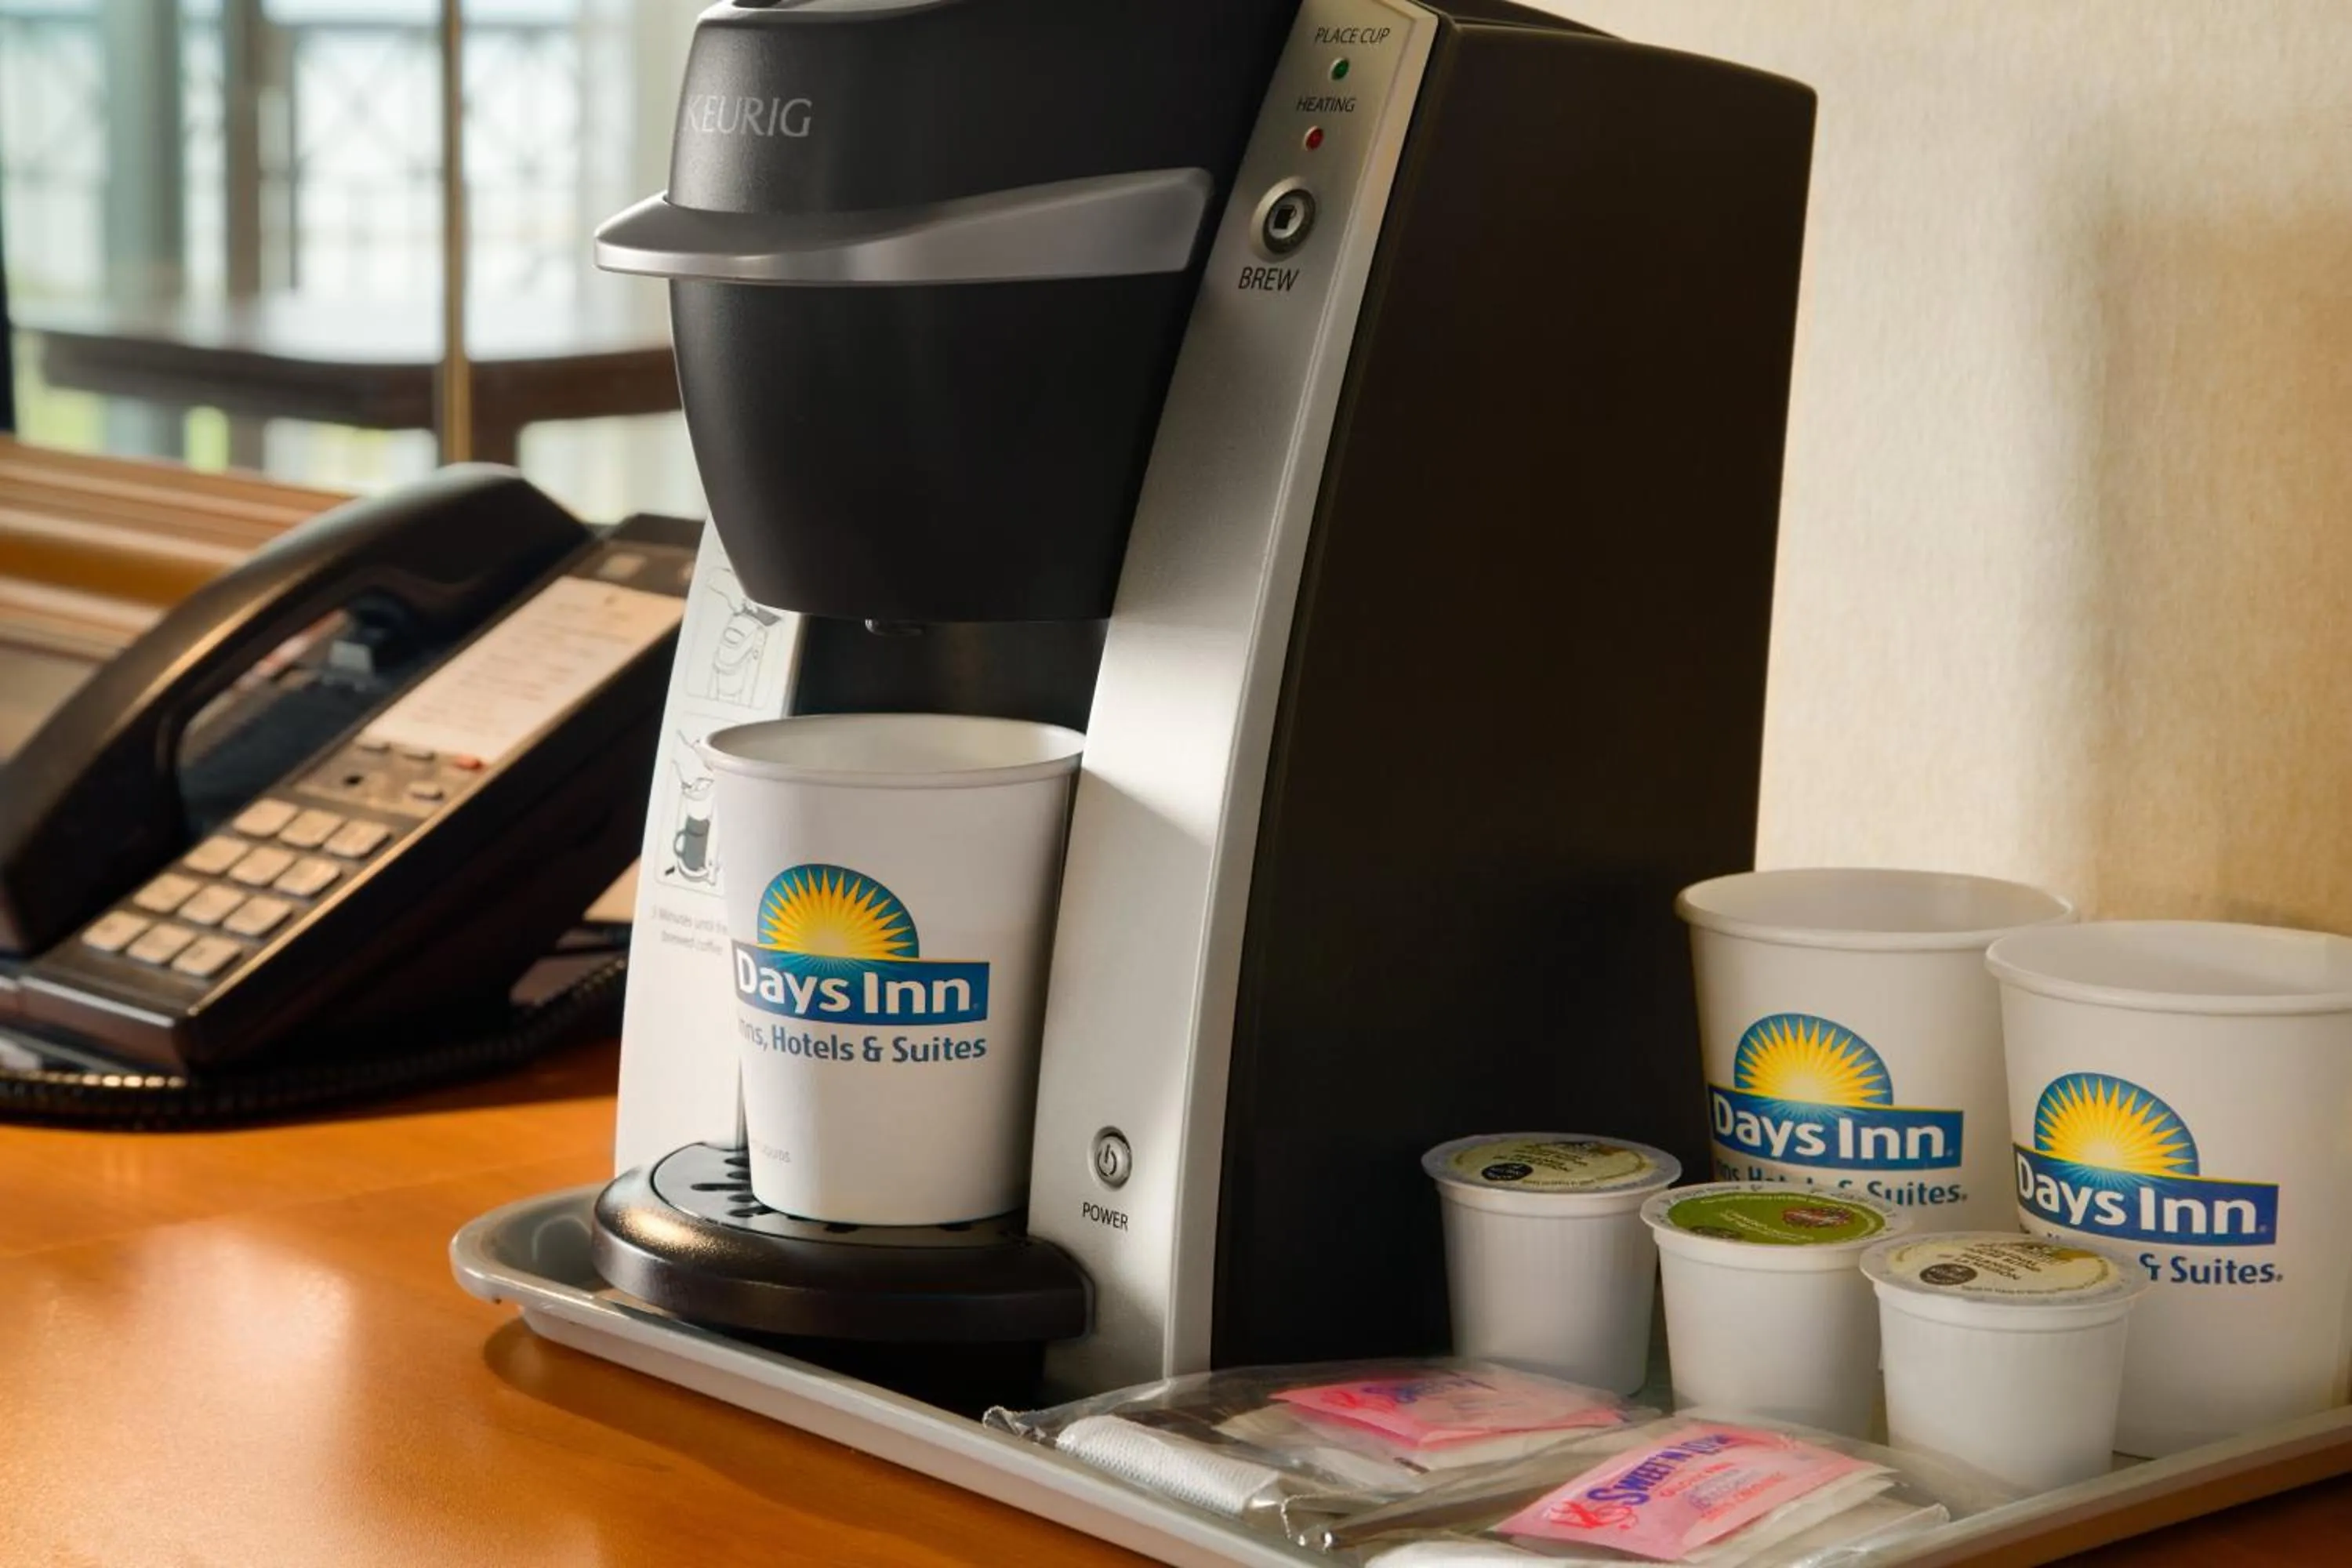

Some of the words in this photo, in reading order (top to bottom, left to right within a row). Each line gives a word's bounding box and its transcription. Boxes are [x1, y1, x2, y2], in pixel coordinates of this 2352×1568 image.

[1315, 27, 1360, 44] PLACE
[1360, 27, 1391, 44] CUP
[684, 94, 812, 137] KEURIG
[1296, 96, 1356, 112] HEATING
[1238, 266, 1300, 291] BREW
[735, 948, 851, 1014] Days
[863, 971, 971, 1014] Inn
[771, 1024, 855, 1062] Hotels
[863, 1036, 884, 1063] &
[892, 1036, 986, 1063] Suites
[1713, 1092, 1827, 1158] Days
[1838, 1117, 1945, 1160] Inn
[2016, 1152, 2127, 1226] Days
[2139, 1186, 2257, 1235] Inn
[1082, 1201, 1128, 1232] POWER
